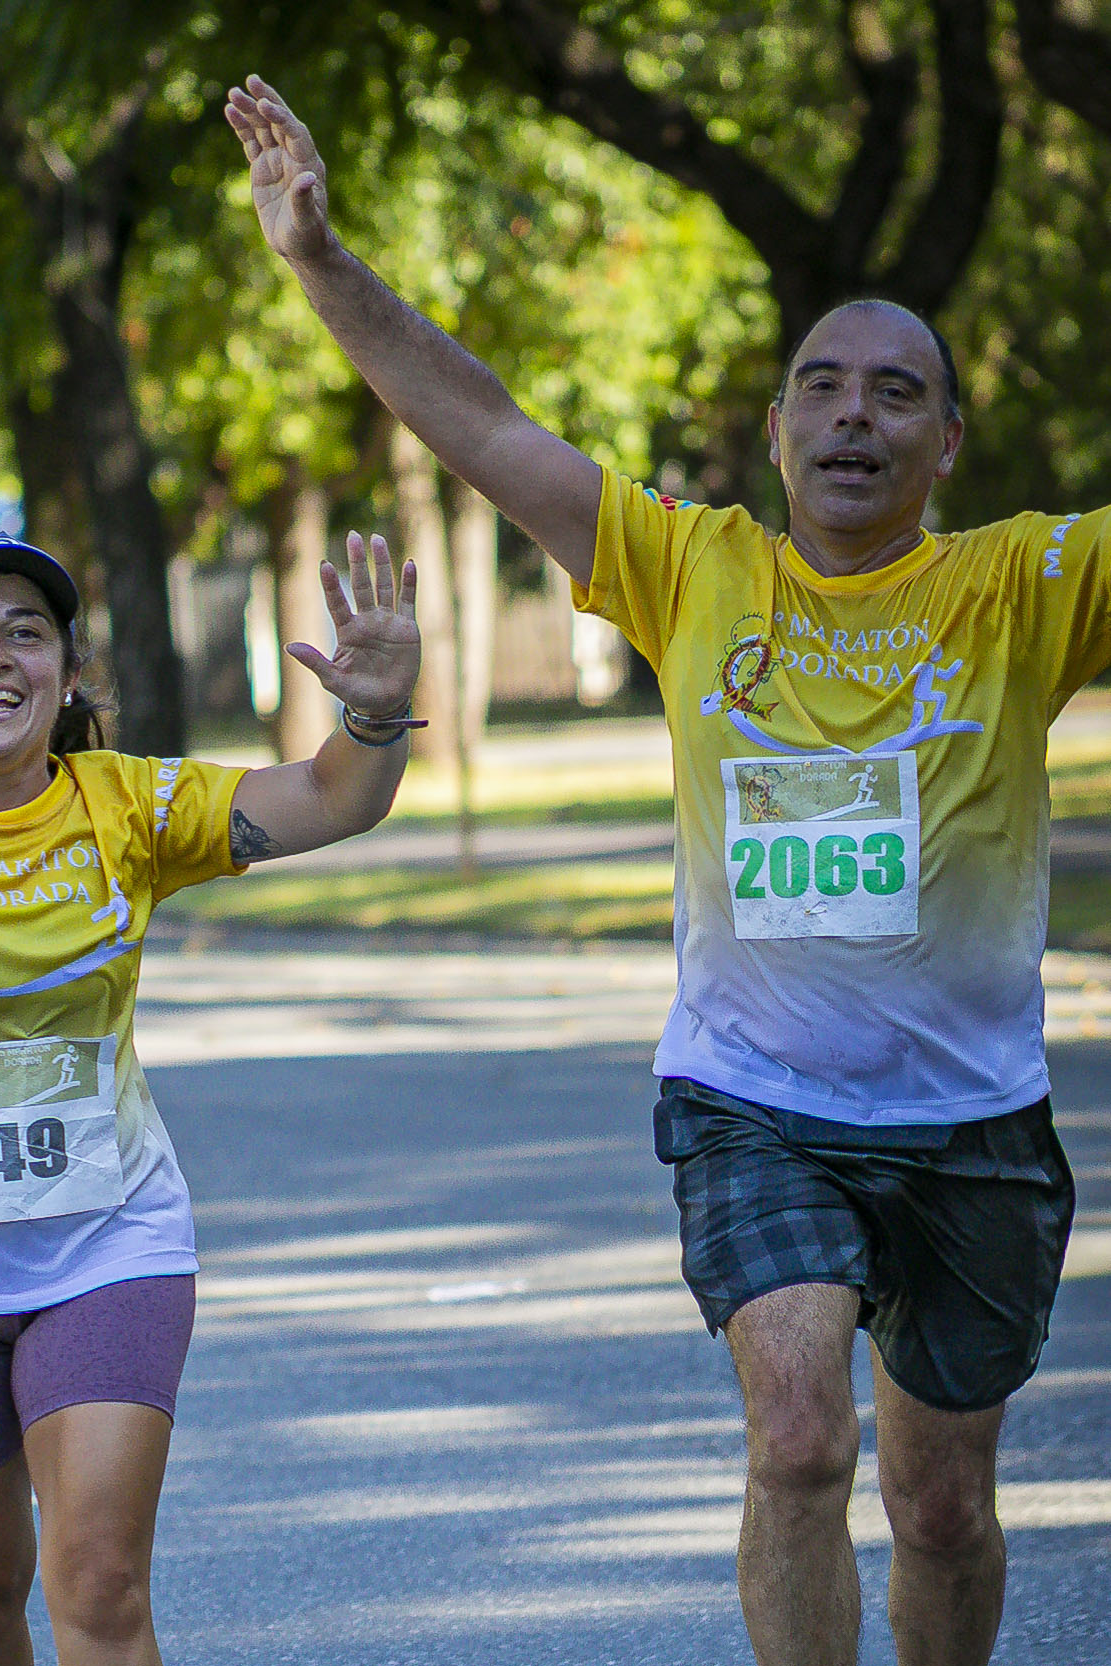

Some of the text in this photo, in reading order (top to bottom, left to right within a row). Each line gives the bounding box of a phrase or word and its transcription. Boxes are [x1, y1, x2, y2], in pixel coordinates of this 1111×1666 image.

[788, 614, 929, 653] MARATÓN
[779, 645, 904, 687] DORADA
[730, 832, 906, 899] 2063
